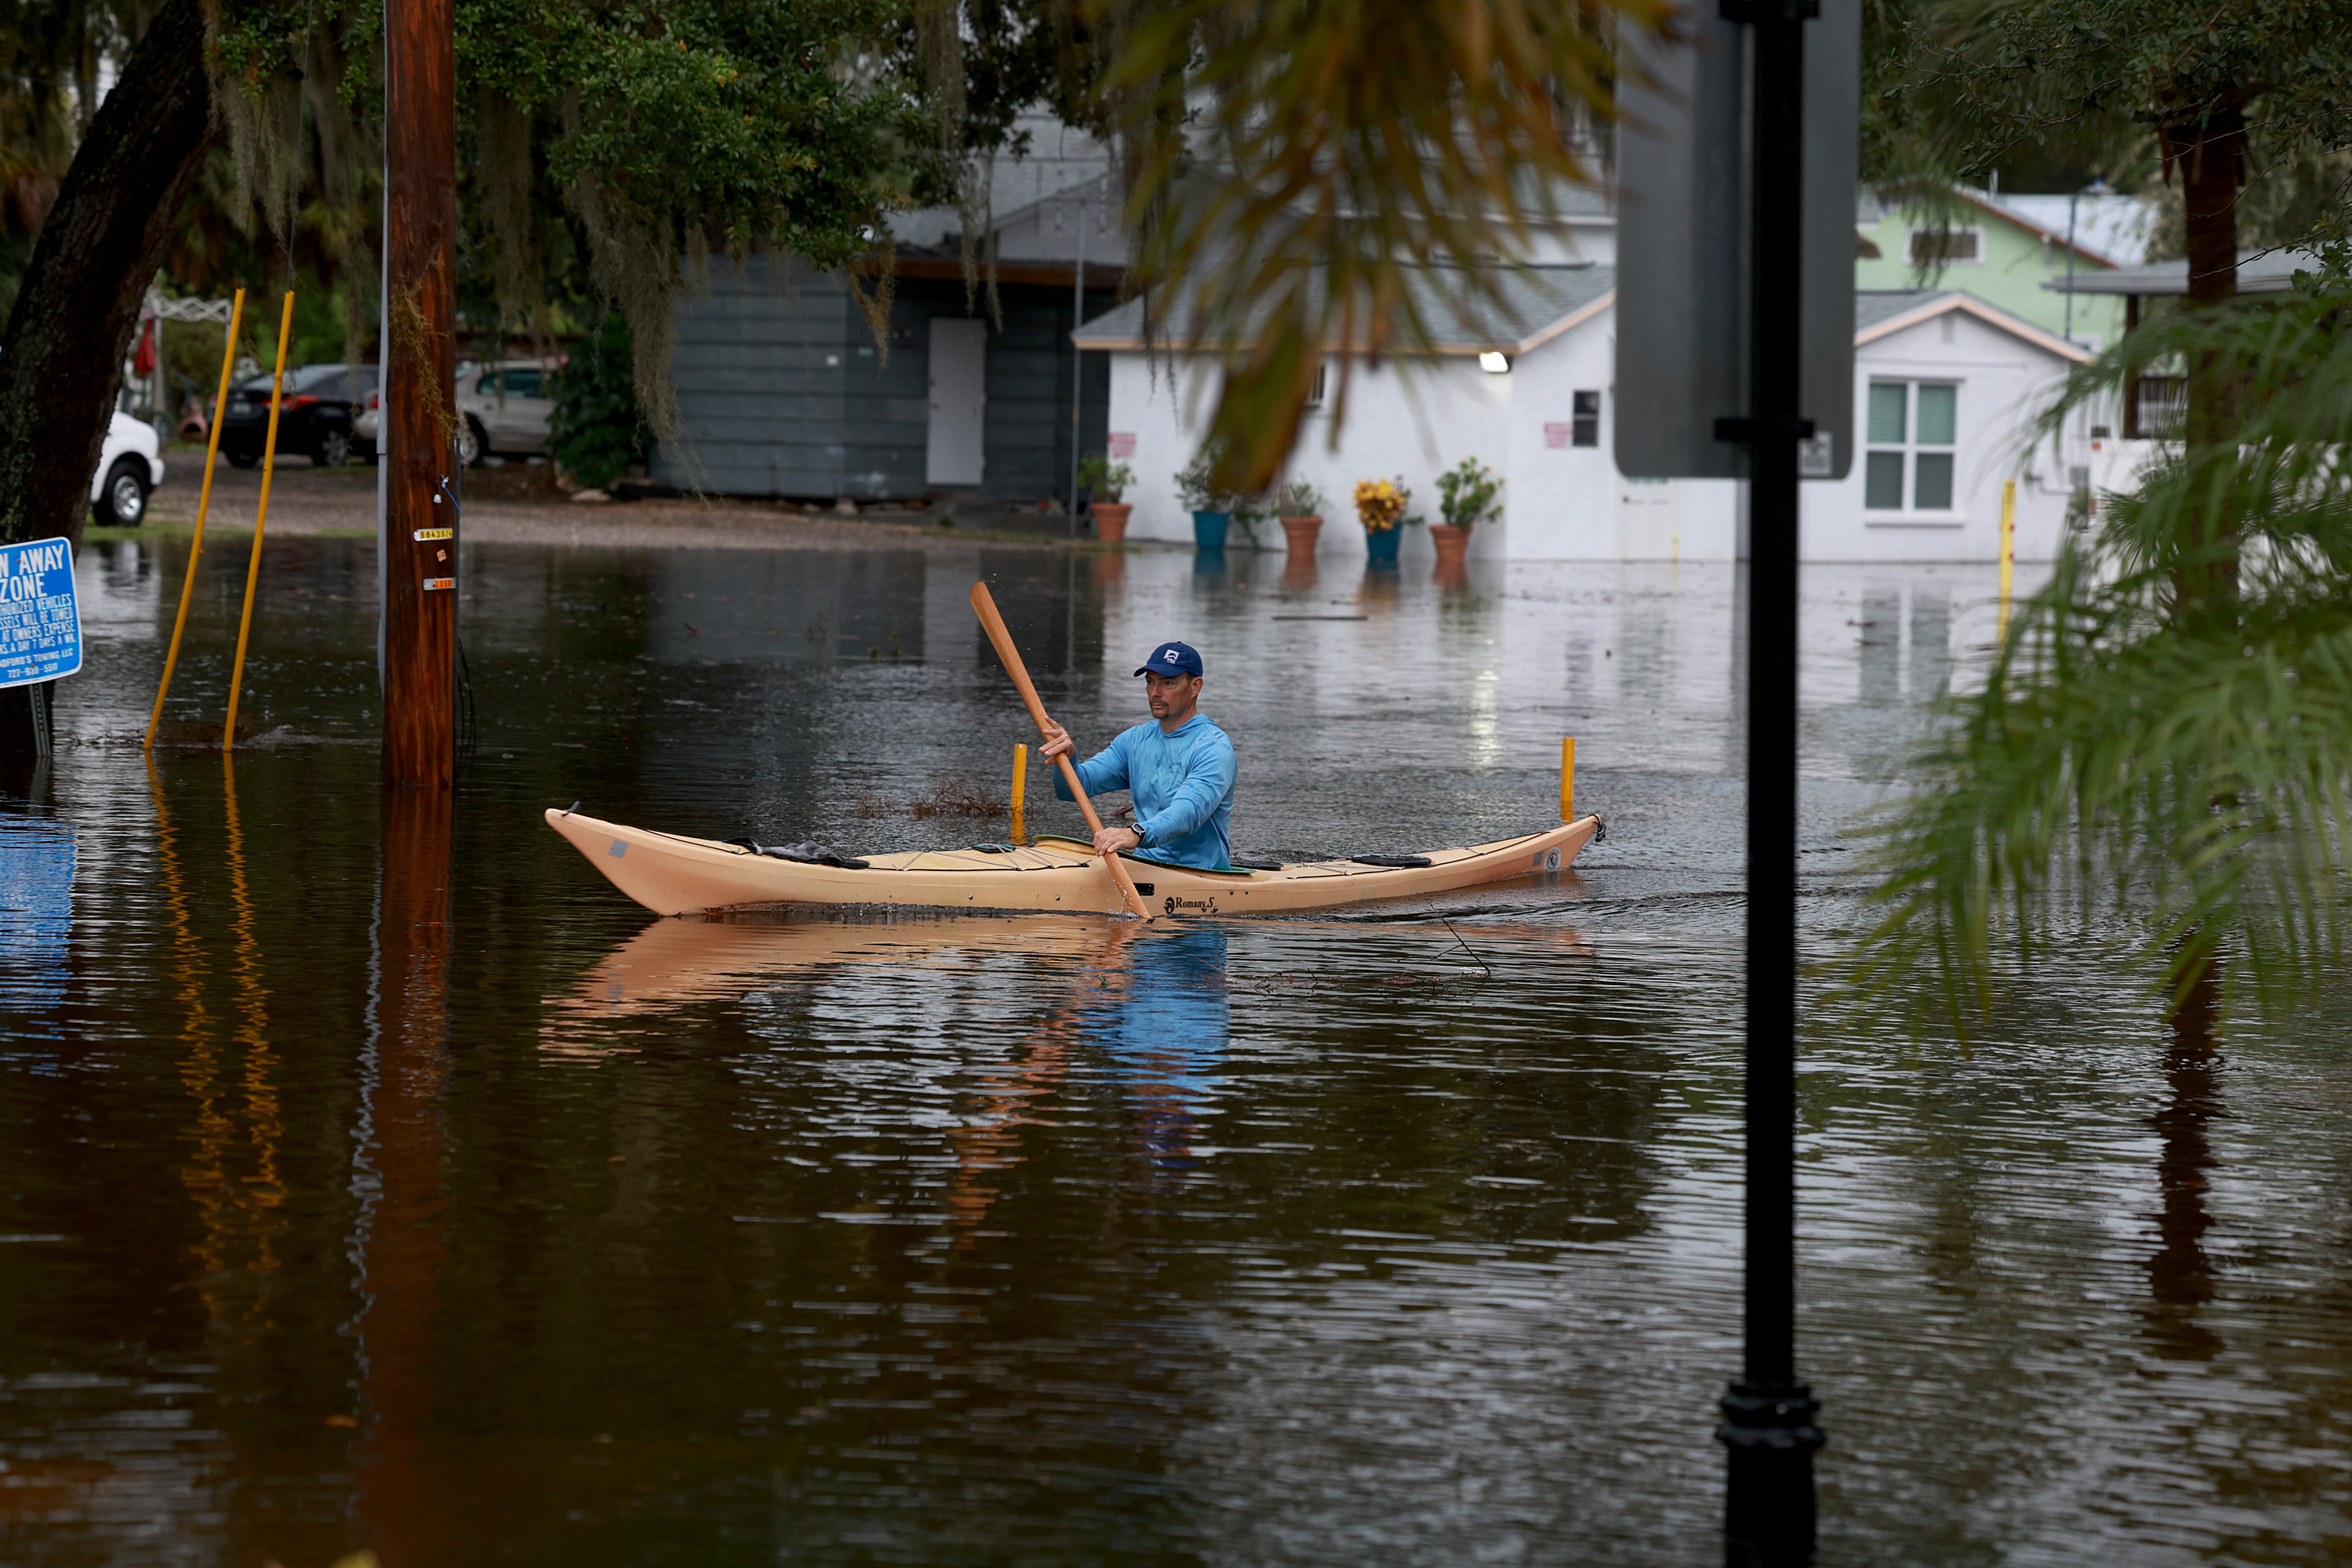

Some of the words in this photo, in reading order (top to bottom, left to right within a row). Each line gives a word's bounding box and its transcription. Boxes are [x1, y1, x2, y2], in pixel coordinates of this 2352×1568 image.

[19, 544, 64, 575] AWAY
[0, 573, 48, 603] ZONE
[36, 593, 72, 610] VEHICLES
[21, 612, 39, 626] WILL
[39, 611, 49, 624] BE
[50, 607, 74, 622] TOWED
[2, 630, 10, 643] AT
[43, 619, 75, 637] EXPENSE
[17, 640, 31, 652] DAY
[31, 638, 37, 649] 7
[38, 636, 56, 648] DAYS
[58, 635, 63, 645] A
[33, 651, 60, 662] TOWING
[61, 648, 74, 658] LLC
[1175, 897, 1207, 909] Romany
[1207, 897, 1214, 907] S
